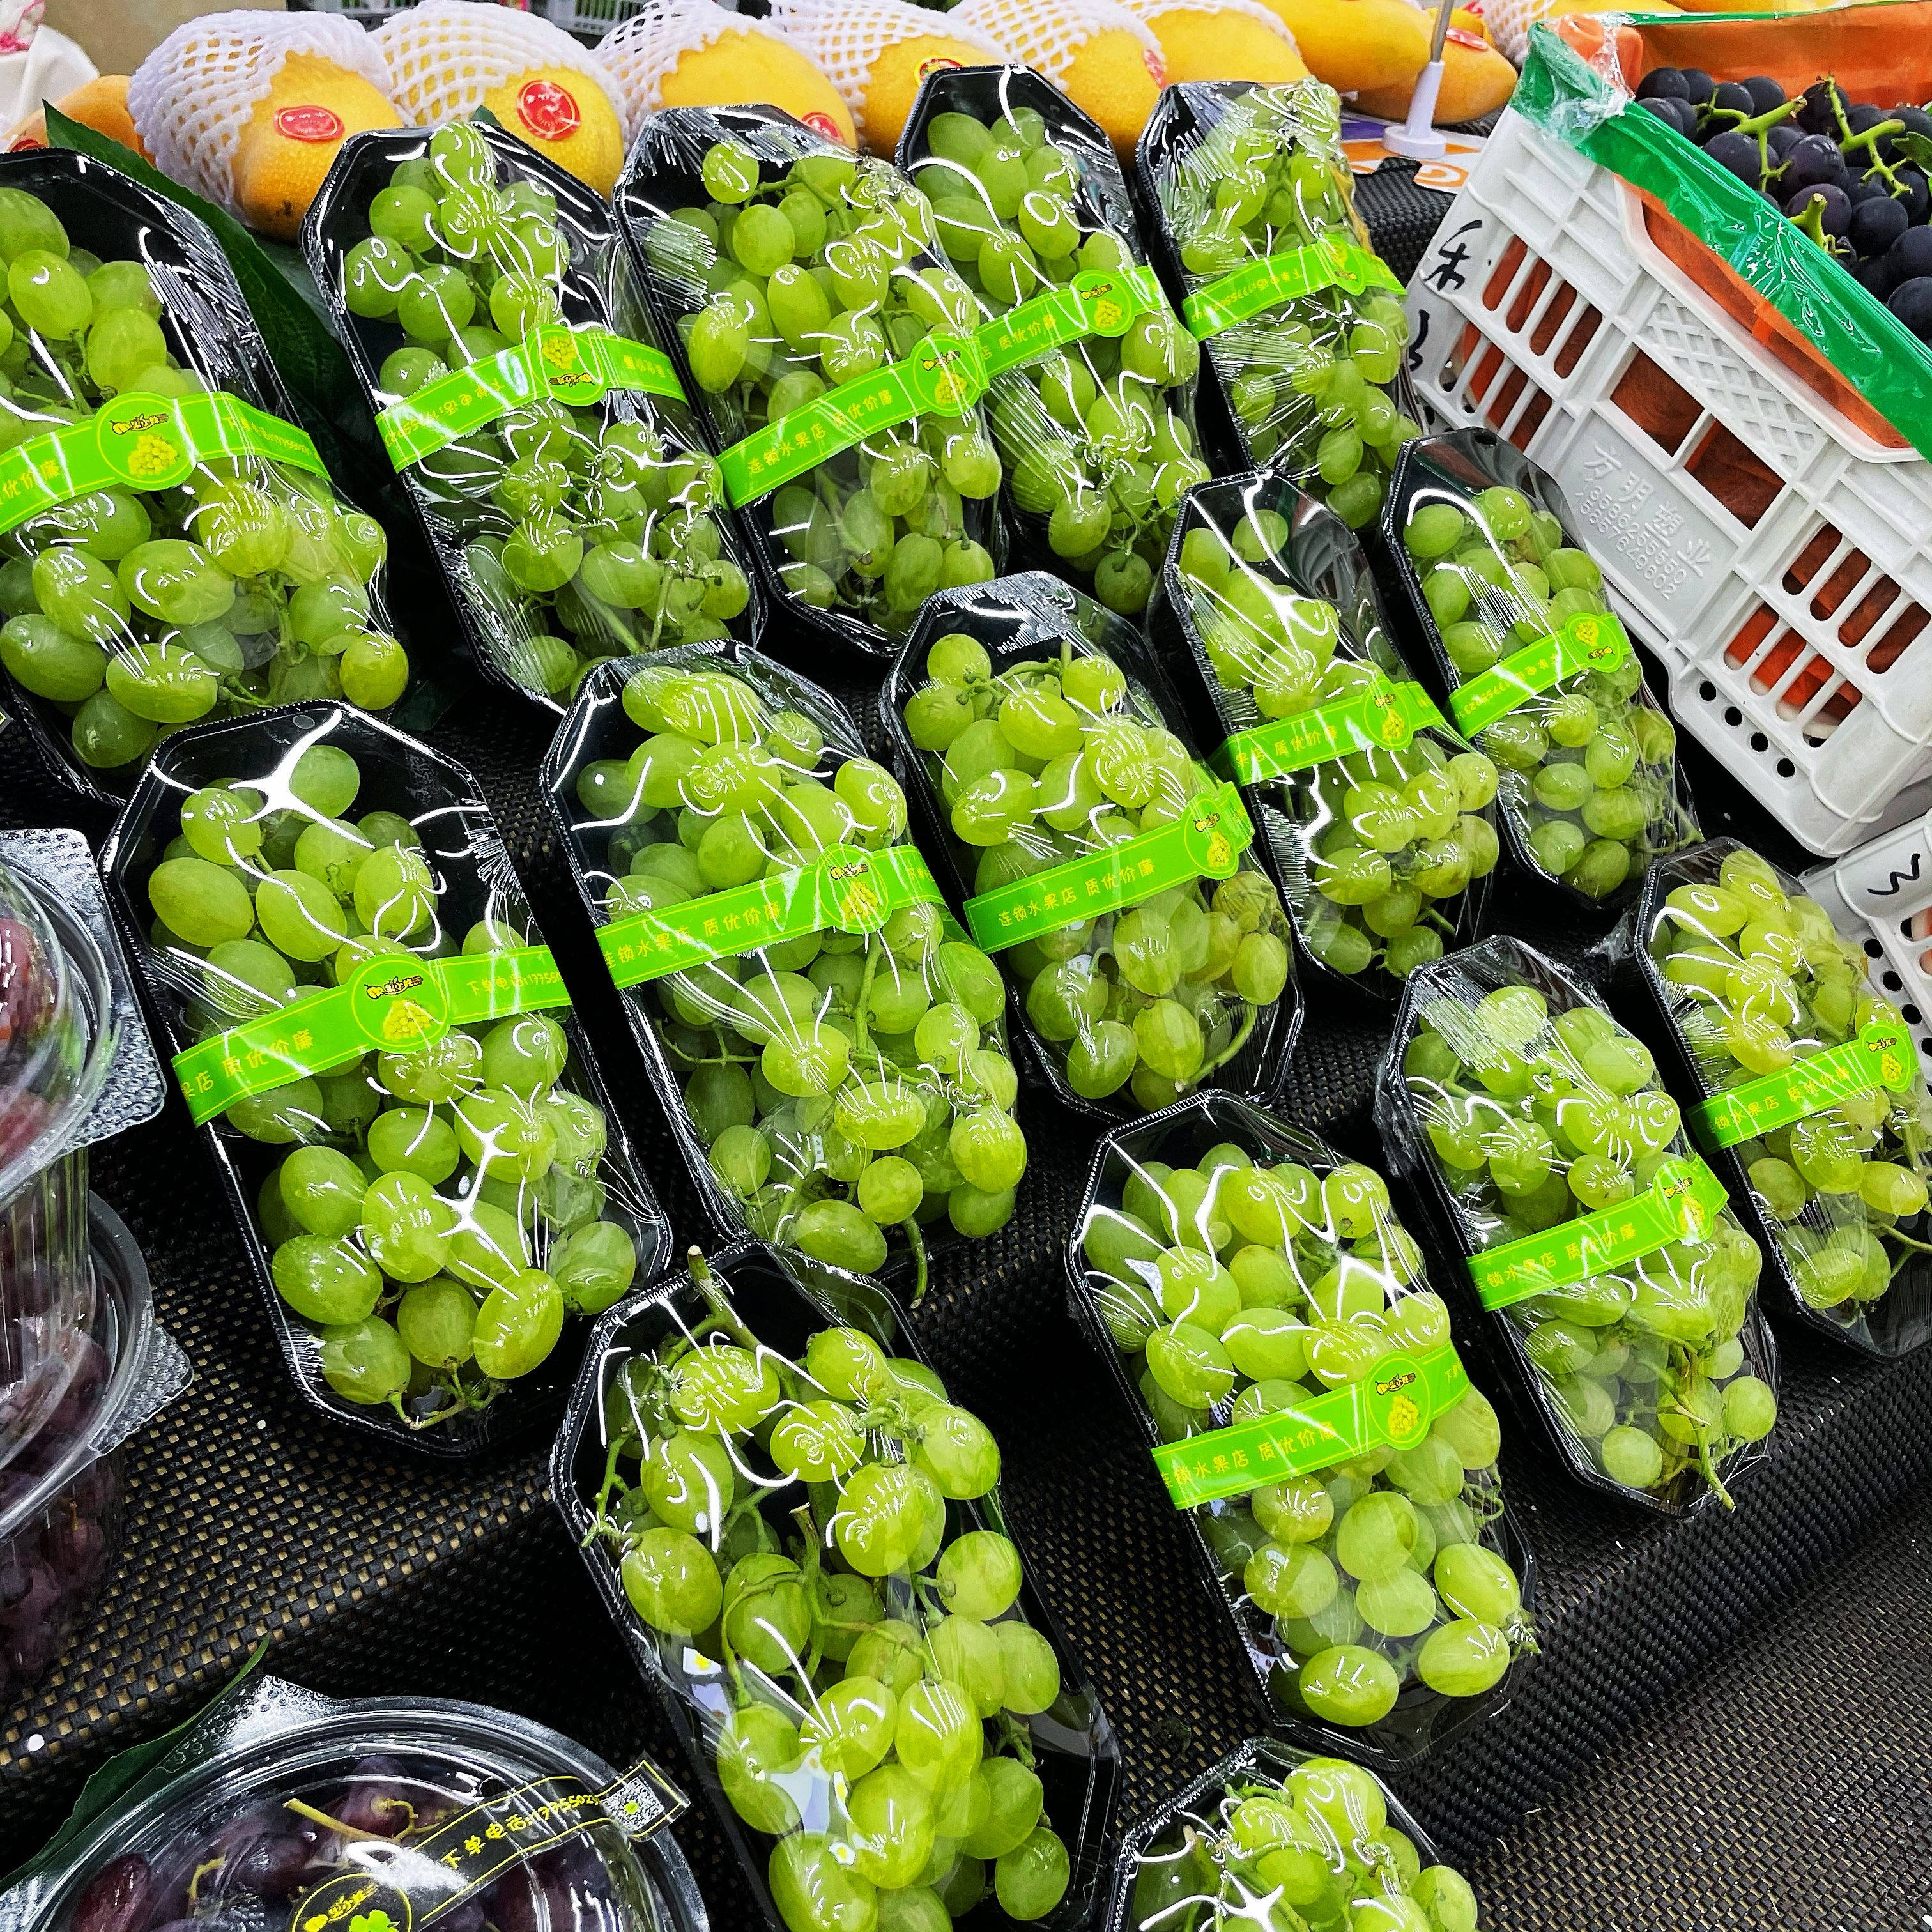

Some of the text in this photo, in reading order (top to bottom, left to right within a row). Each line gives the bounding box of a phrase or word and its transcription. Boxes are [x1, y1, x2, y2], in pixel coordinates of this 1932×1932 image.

[998, 312, 1056, 351] 质优价廉
[747, 388, 894, 475] 连锁水果店 质优价廉
[0, 459, 60, 505] 优价廉
[1583, 443, 1711, 578] 方明塑业
[1275, 725, 1338, 757] 质优价廉
[998, 858, 1156, 928] 连锁水果店 质优价廉
[703, 901, 781, 938] 质优价廉
[222, 1029, 314, 1078] 质优价廉
[1786, 1066, 1850, 1103] 质优价廉
[1565, 1223, 1637, 1262] 质优价廉
[1257, 1421, 1337, 1462] 质优价廉
